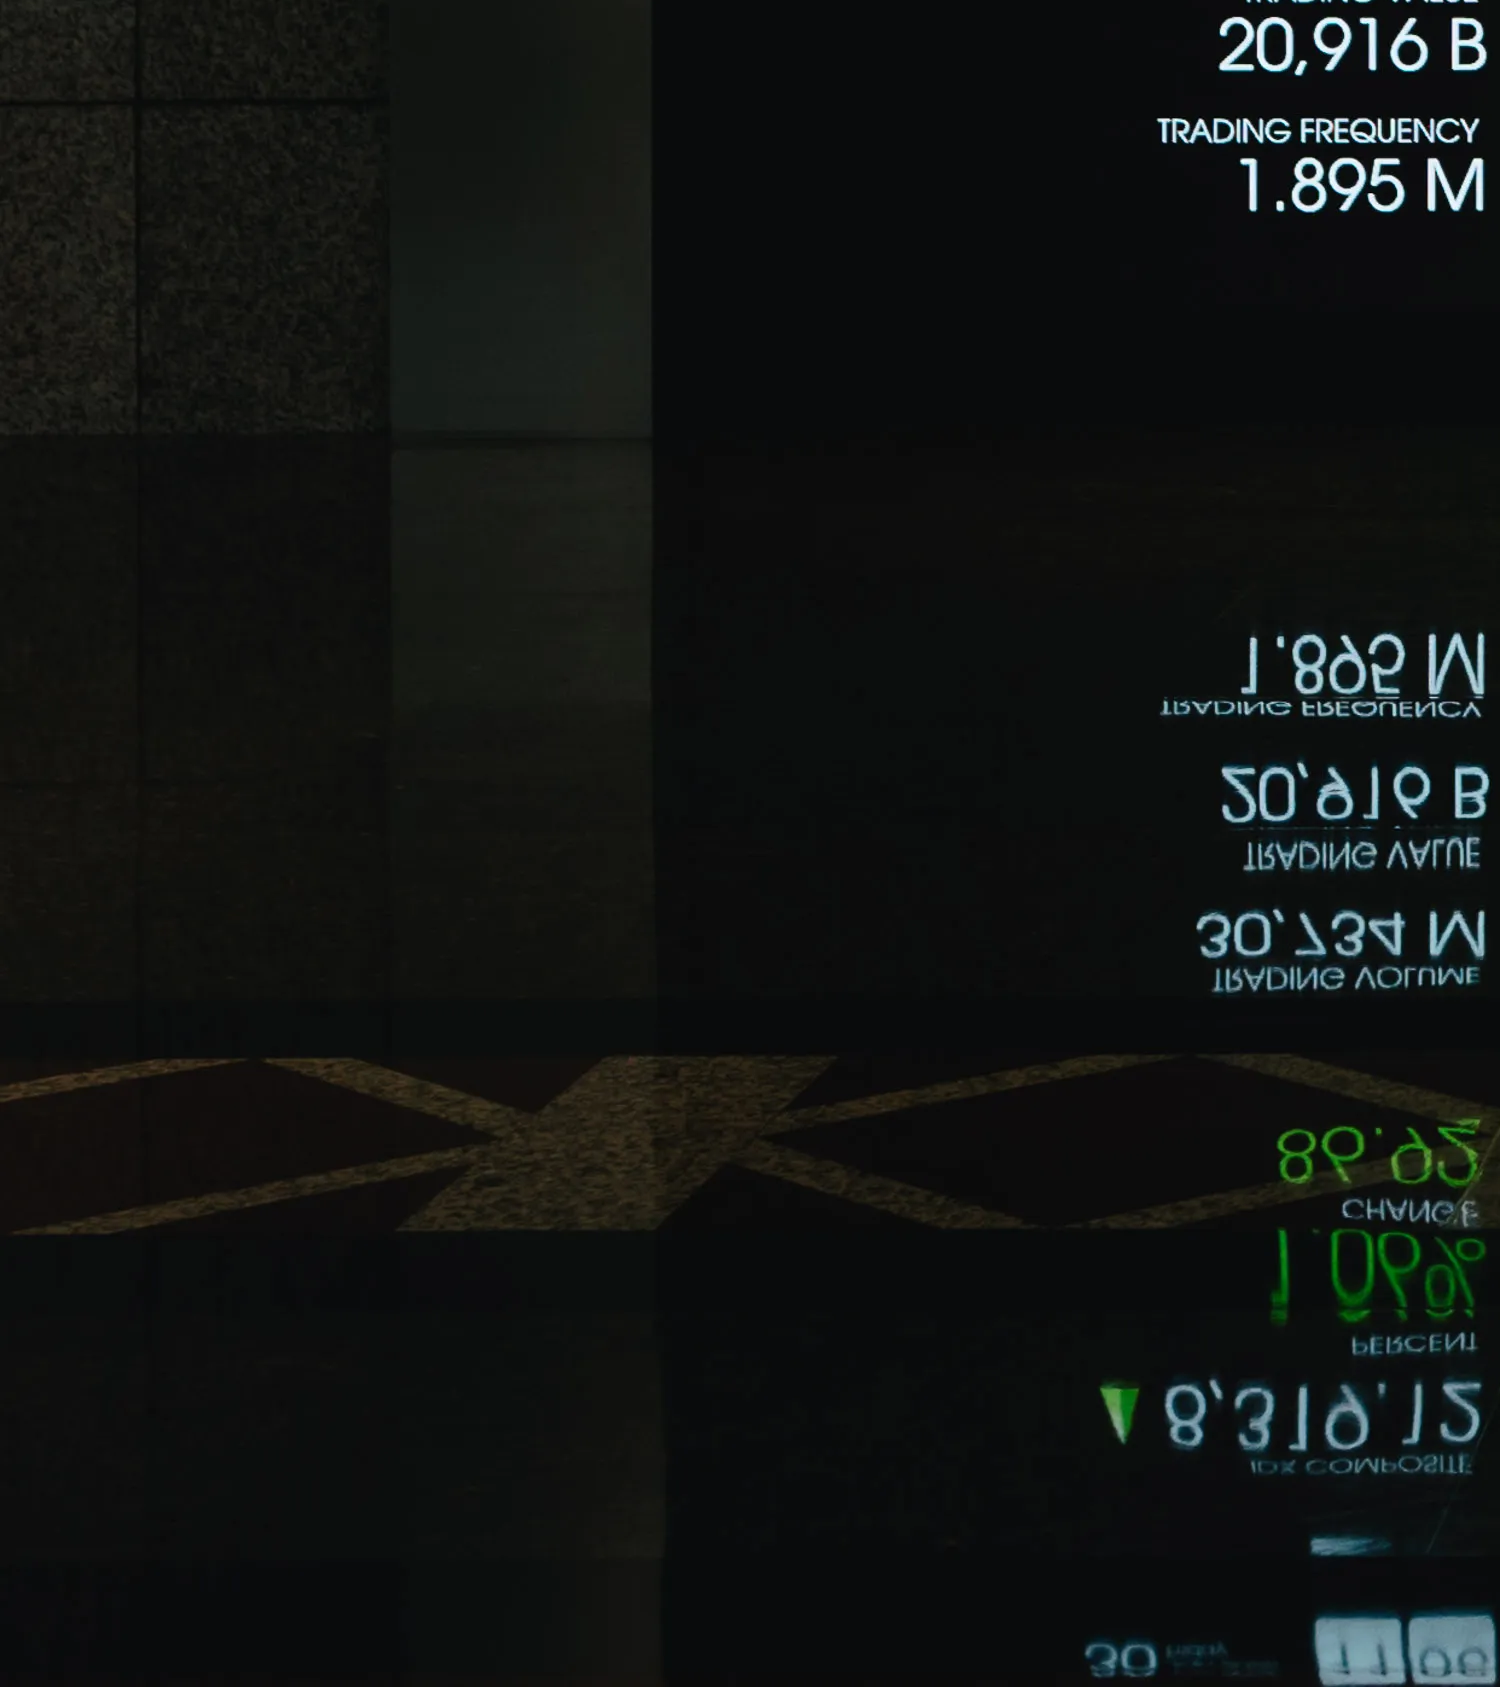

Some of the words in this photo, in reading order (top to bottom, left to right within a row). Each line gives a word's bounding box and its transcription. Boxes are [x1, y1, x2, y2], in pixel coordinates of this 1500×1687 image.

[1219, 17, 1428, 76] 20,916
[1452, 18, 1487, 71] B
[1157, 118, 1291, 143] TRADING
[1301, 118, 1479, 143] FREQUENCY
[1240, 157, 1405, 213] 1.895
[1427, 158, 1483, 211] M
